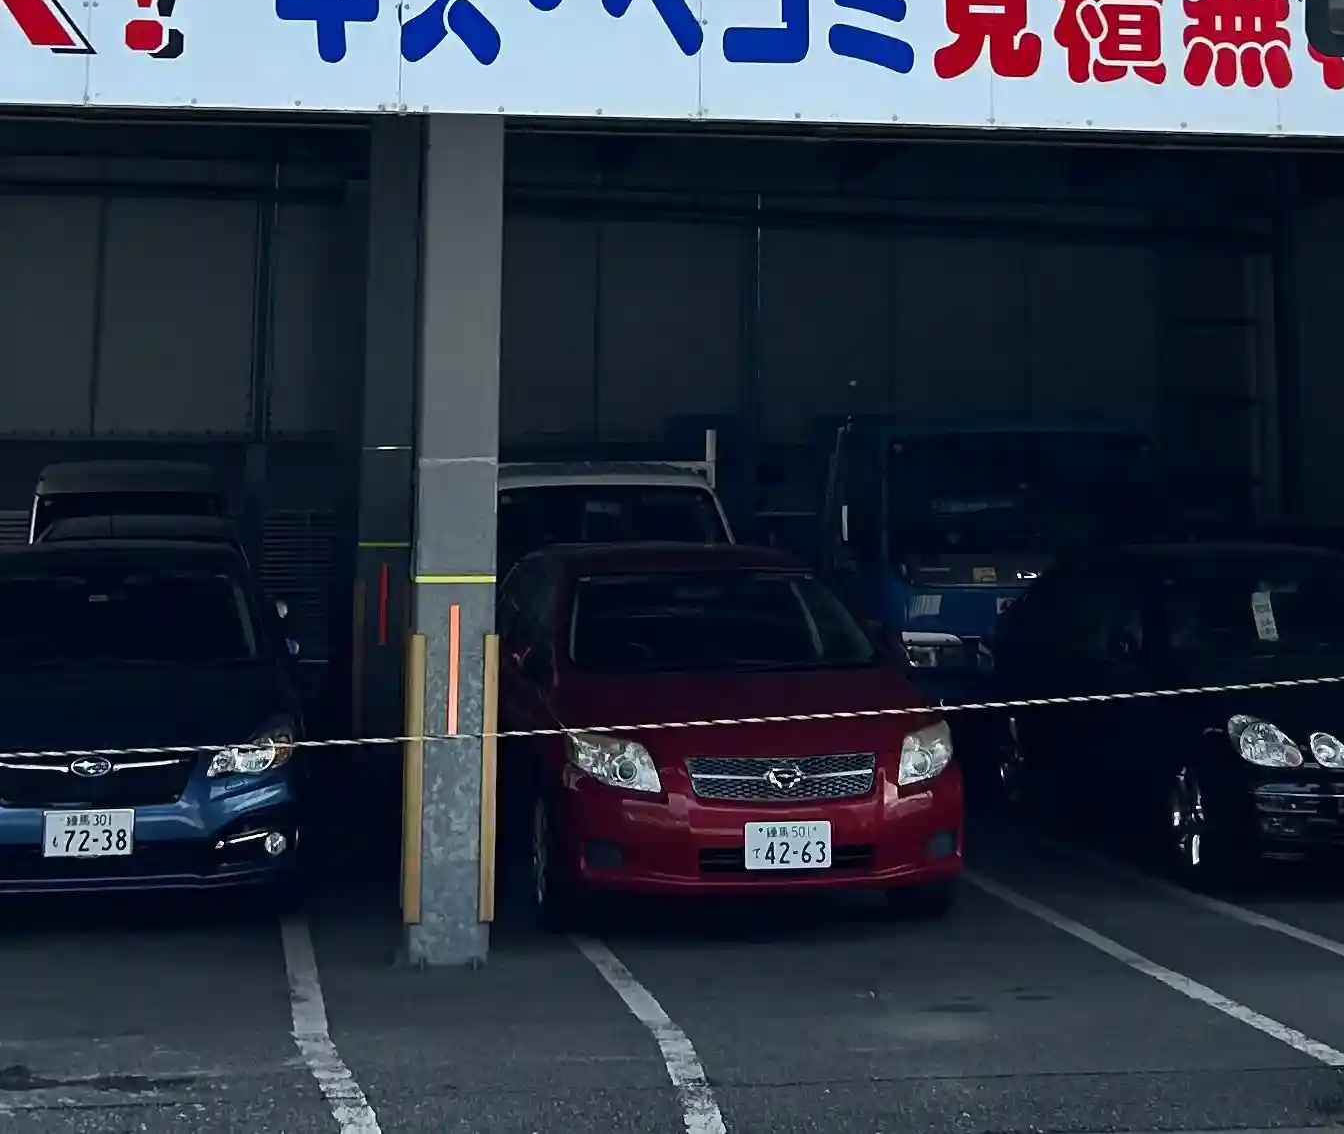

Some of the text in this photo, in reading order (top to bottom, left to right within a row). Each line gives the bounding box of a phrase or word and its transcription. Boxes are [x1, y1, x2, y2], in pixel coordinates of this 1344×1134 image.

[93, 814, 112, 826] 301
[64, 829, 127, 853] 72-38
[765, 841, 826, 864] 42-63
